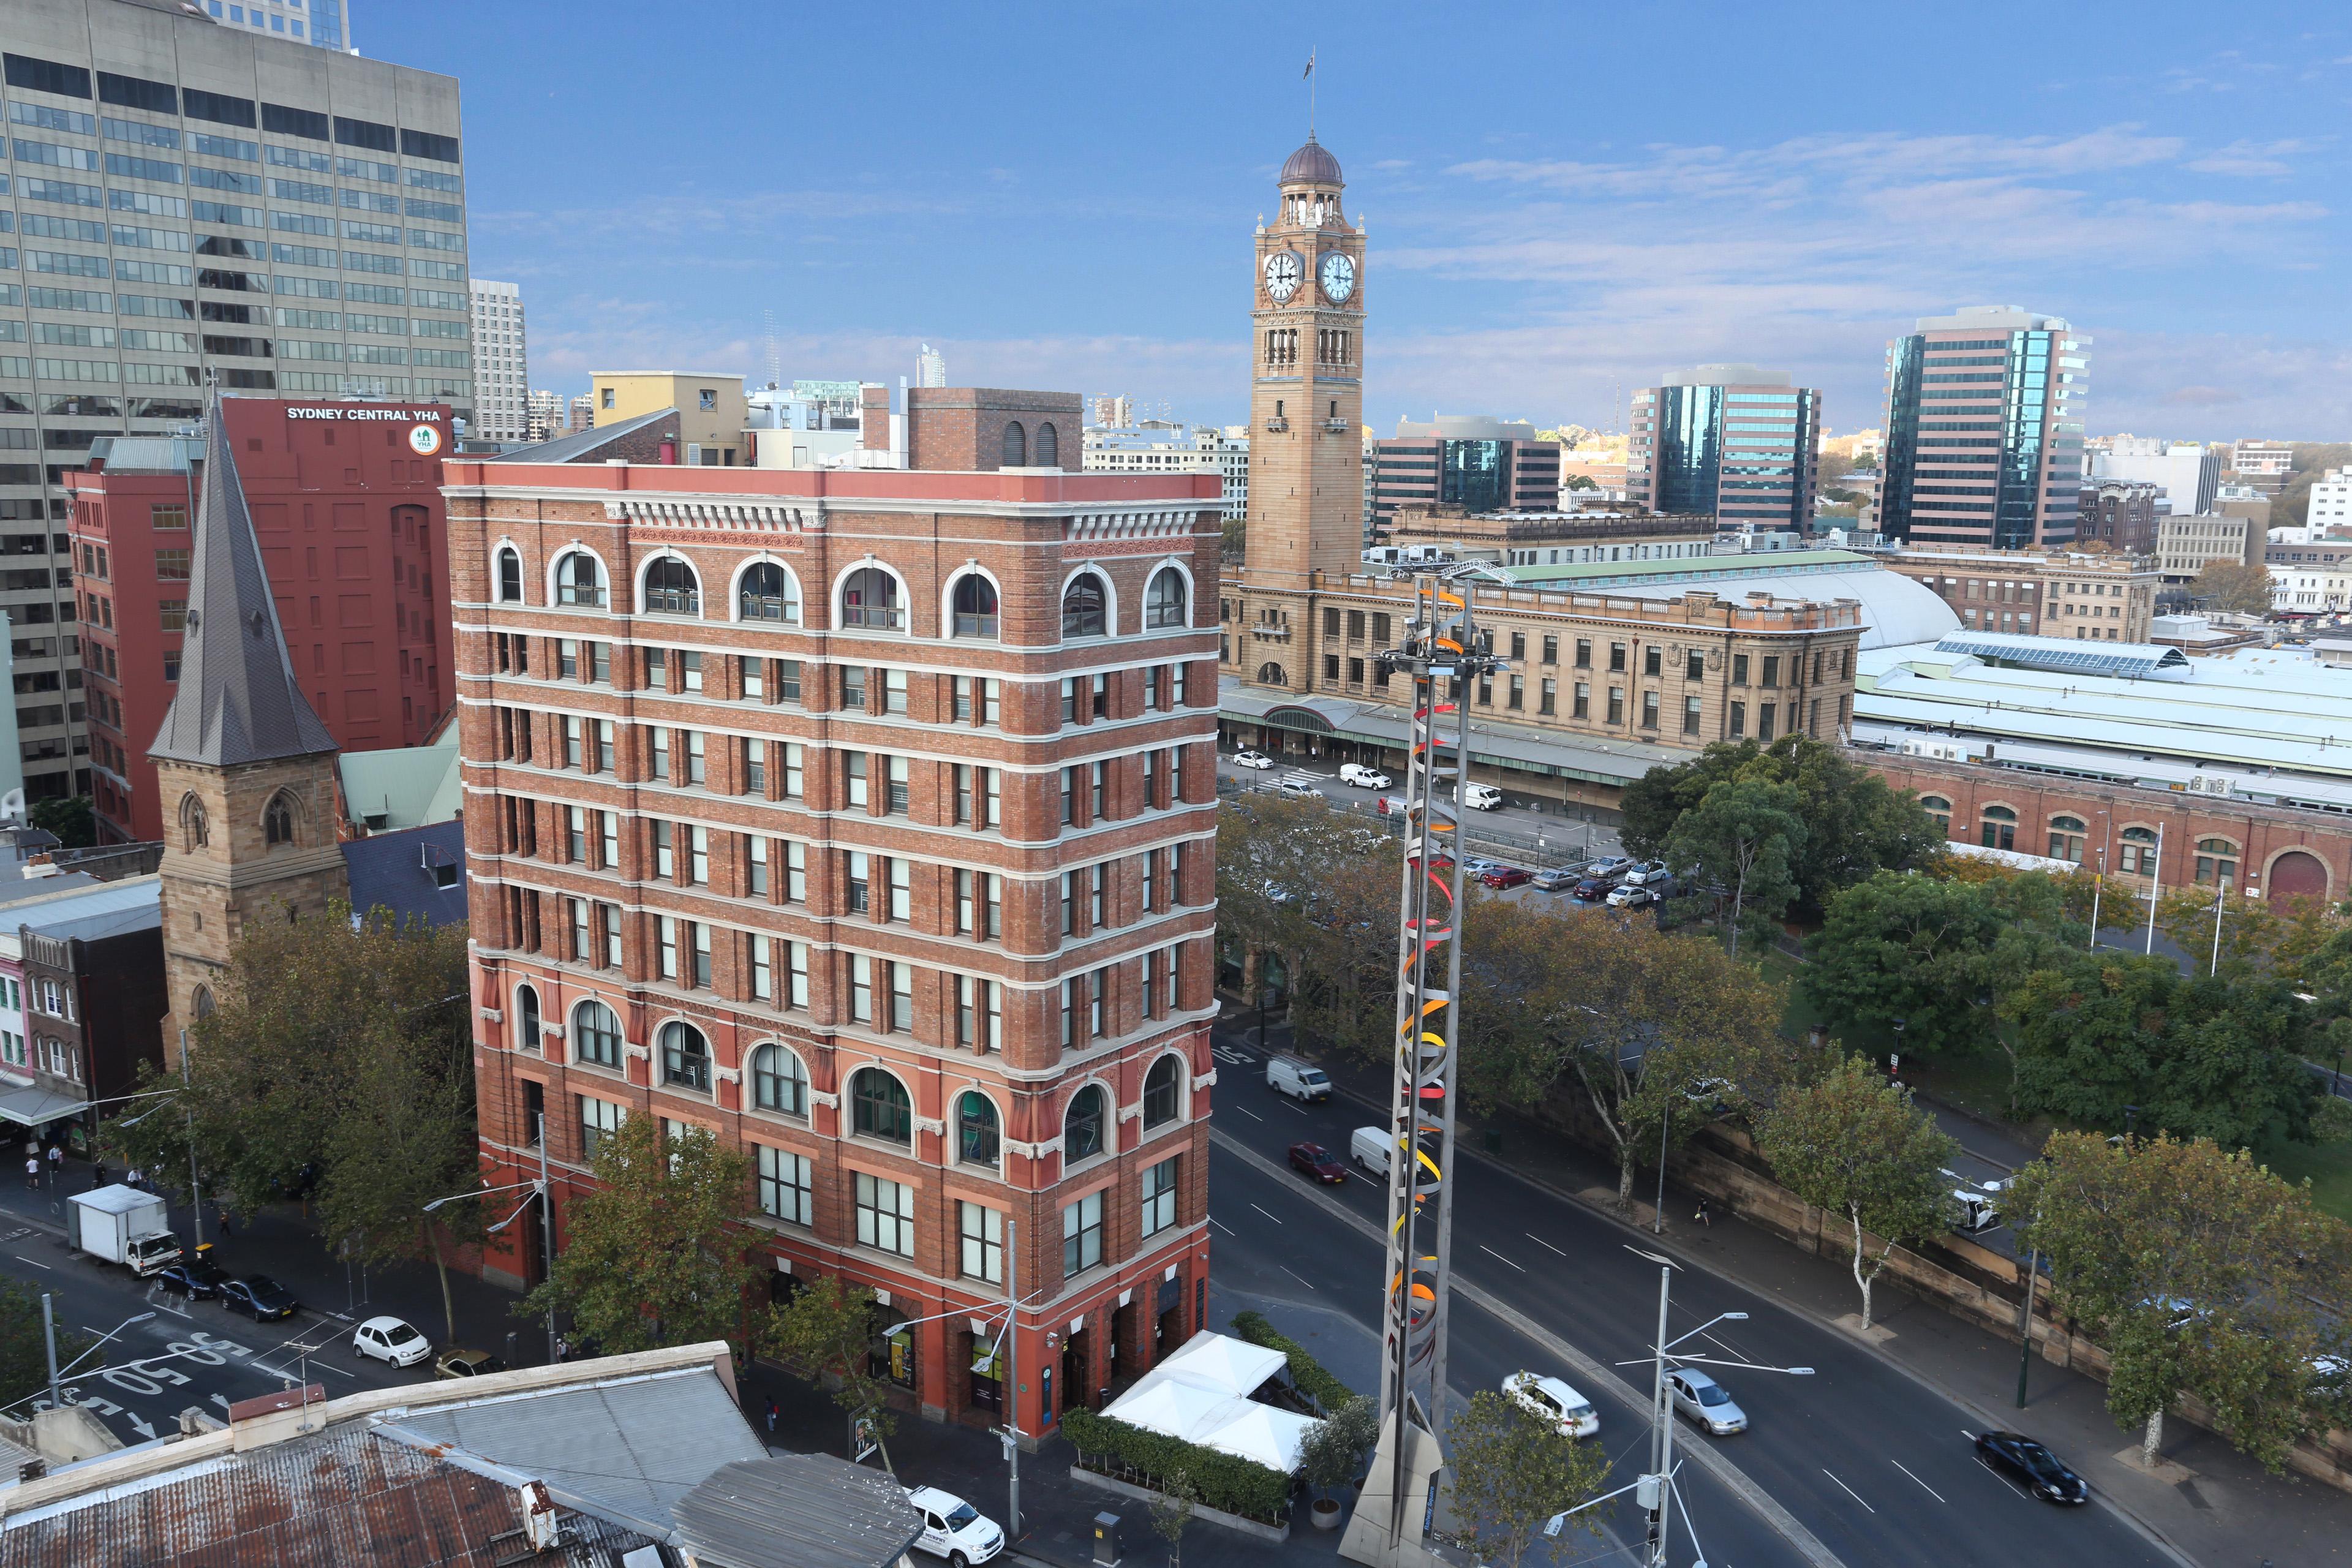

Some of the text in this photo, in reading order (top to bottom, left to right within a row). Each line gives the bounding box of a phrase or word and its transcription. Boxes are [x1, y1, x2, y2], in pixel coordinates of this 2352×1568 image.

[287, 407, 440, 421] SYDNEY CENTRAL YHA
[1211, 1046, 1256, 1065] 50
[167, 1332, 254, 1365] 50
[102, 1359, 192, 1395] 50
[925, 1532, 946, 1544] MURPHY
